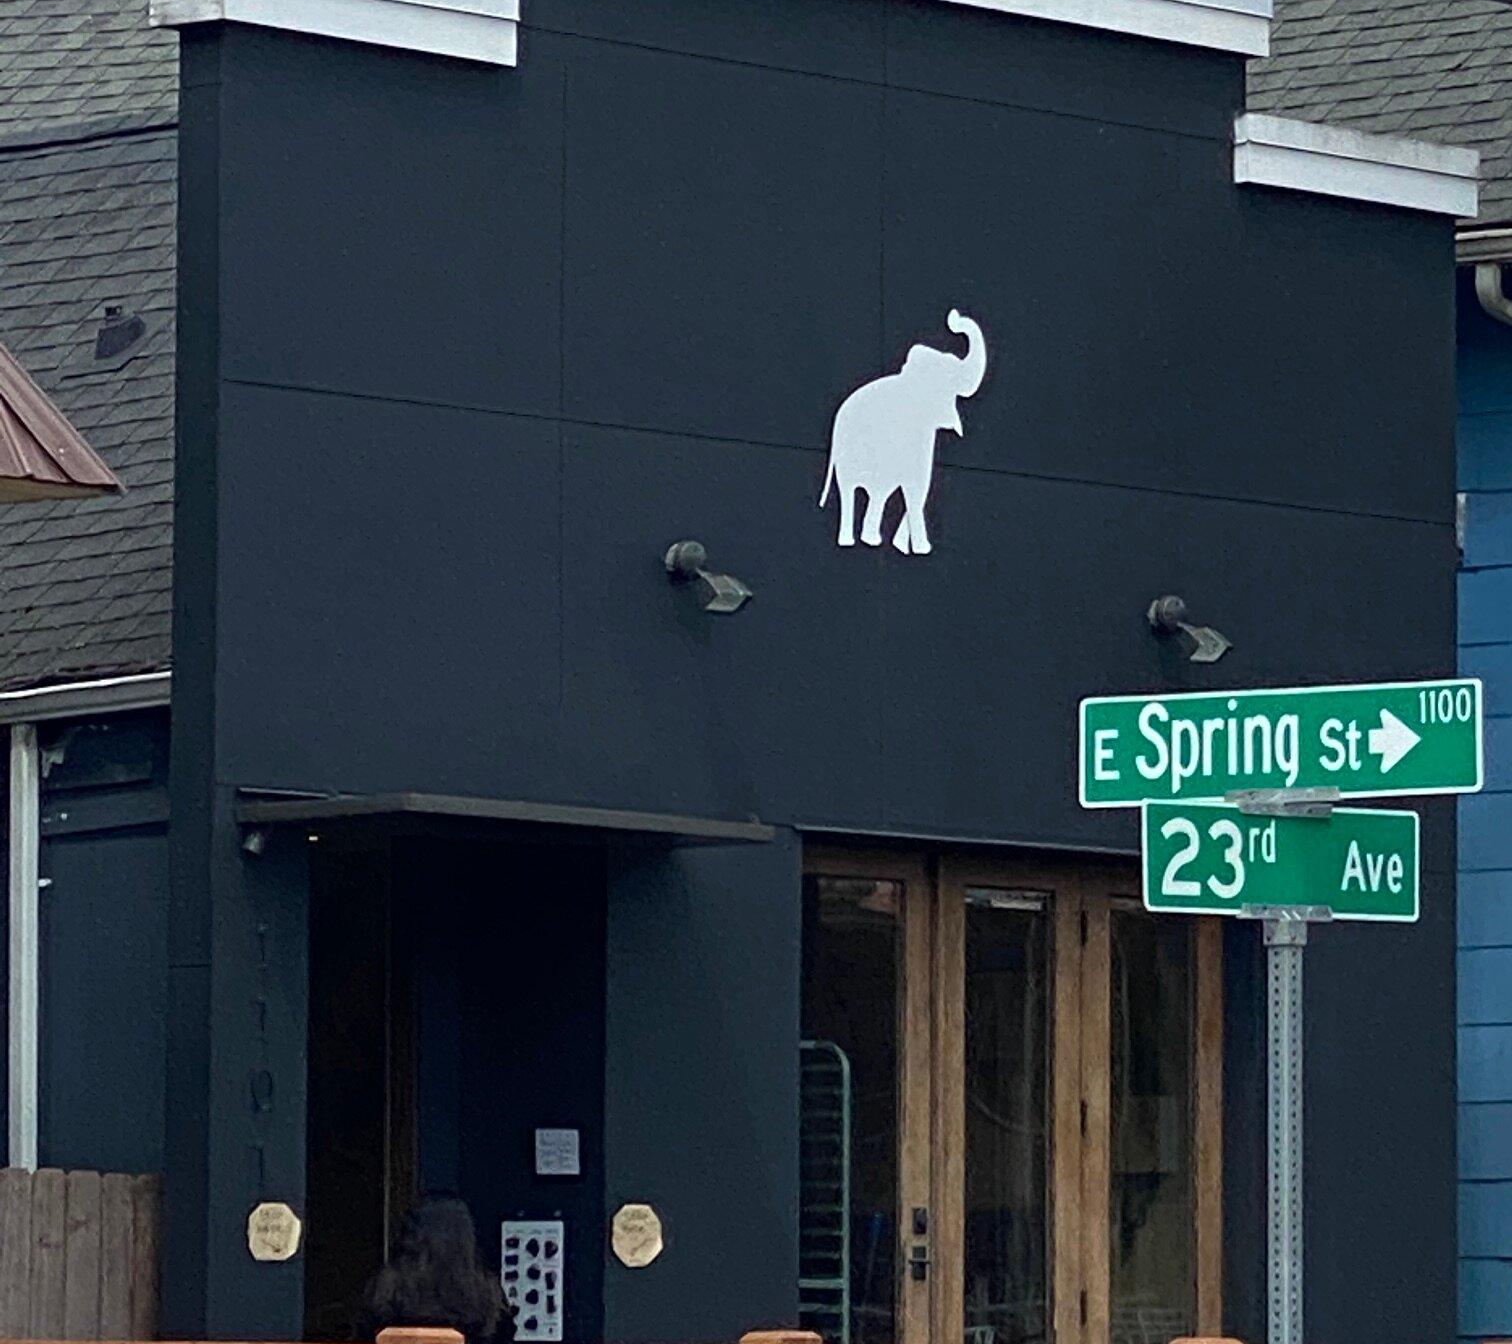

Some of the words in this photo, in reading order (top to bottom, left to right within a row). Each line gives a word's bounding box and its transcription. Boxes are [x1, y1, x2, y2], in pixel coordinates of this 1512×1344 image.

[1093, 729, 1120, 781] E
[1135, 698, 1300, 794] Spring
[1318, 717, 1362, 772] St
[1418, 687, 1472, 724] 1100
[1160, 816, 1277, 899] 23rd
[1340, 839, 1404, 894] Ave
